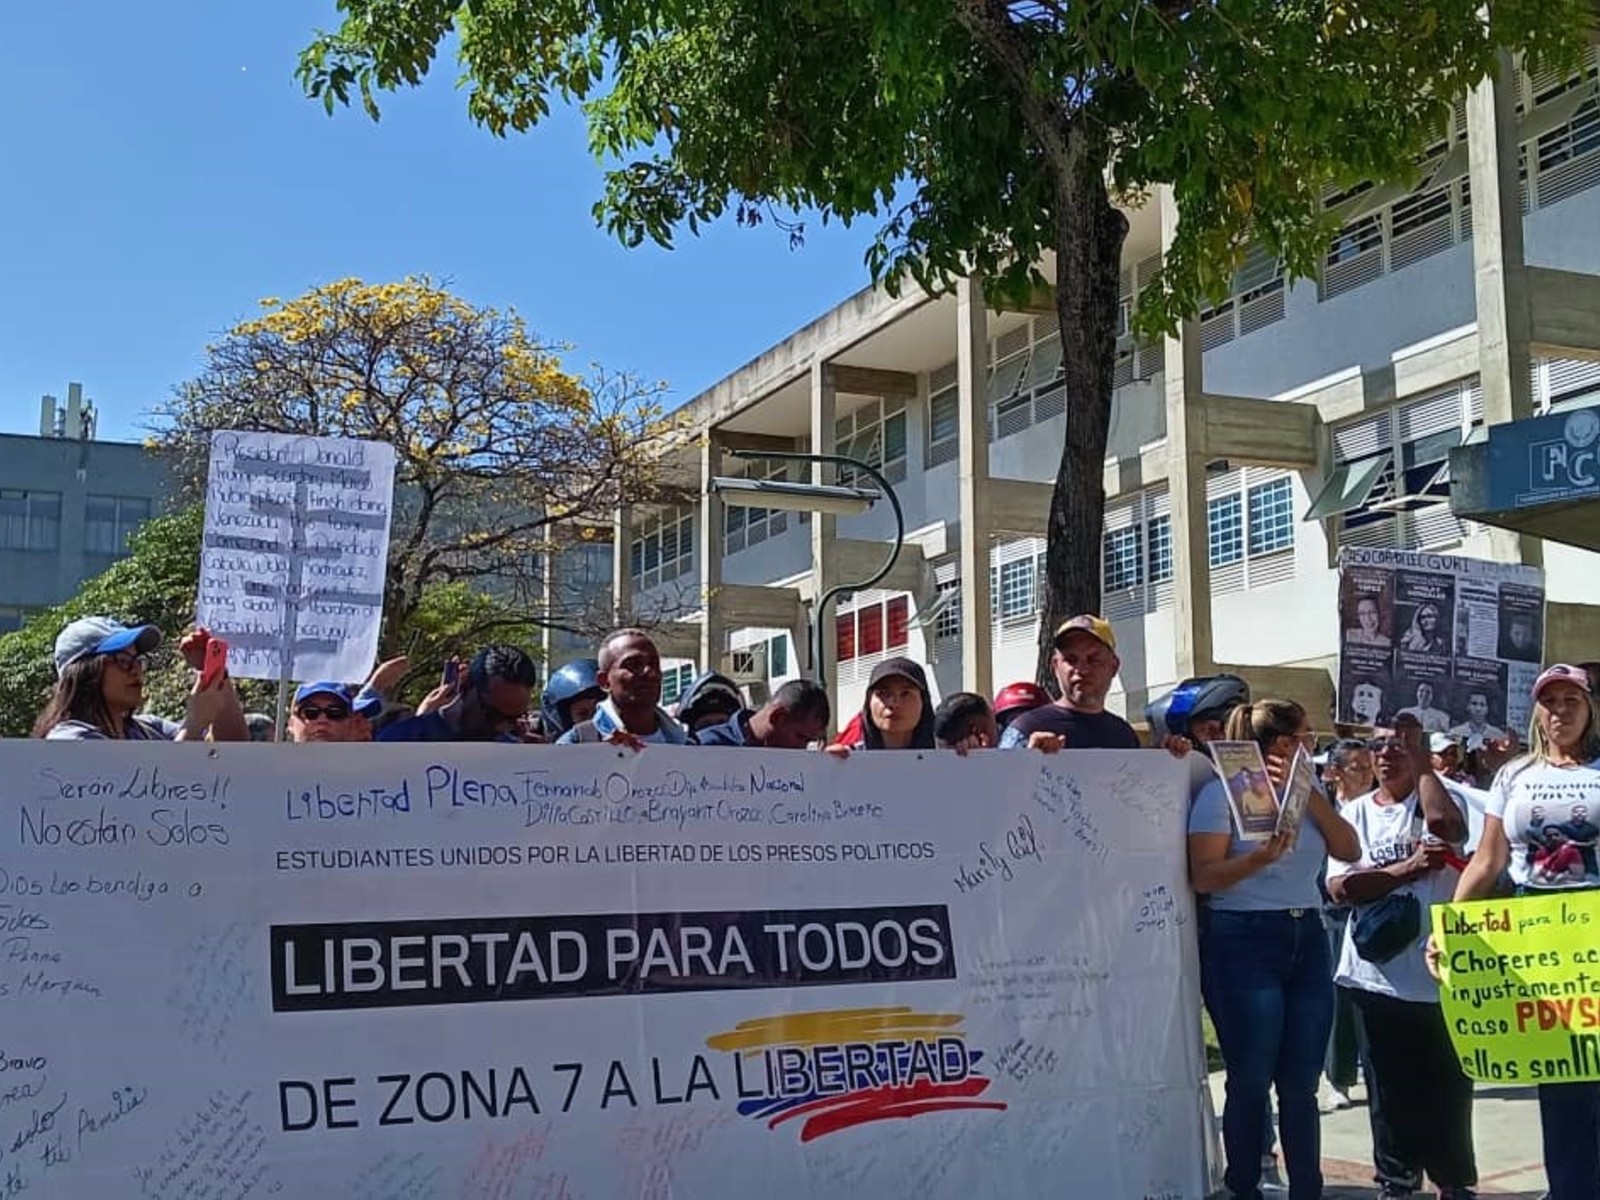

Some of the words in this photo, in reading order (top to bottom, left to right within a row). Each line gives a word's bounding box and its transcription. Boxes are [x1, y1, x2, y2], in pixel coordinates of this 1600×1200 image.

[292, 437, 365, 466] Donald
[276, 849, 434, 870] ESTUDIANTES
[440, 847, 521, 866] UNIDOS
[527, 846, 569, 865] POR
[575, 846, 600, 864] LA
[604, 844, 696, 864] LIBERTAD
[700, 844, 723, 862] DE
[728, 843, 762, 862] LOS
[766, 842, 837, 861] PRESOS
[841, 841, 936, 860] POLITICOS
[1441, 907, 1513, 936] Libertad
[1518, 916, 1552, 935] para
[1561, 902, 1591, 925] los
[284, 930, 588, 996] LIBERTAD
[605, 925, 756, 980] PARA
[763, 917, 945, 973] TODOS
[1451, 948, 1561, 977] Choferes
[1456, 1017, 1509, 1036] caso
[1515, 997, 1600, 1034] PDVS
[1462, 1048, 1519, 1079] ellos
[1529, 1058, 1571, 1079] son
[278, 1077, 360, 1132] DE
[377, 1066, 541, 1126] ZONA
[553, 1062, 583, 1113] 7
[600, 1060, 638, 1110] A
[652, 1055, 721, 1105] LA
[734, 1036, 970, 1098] LIBERTAD
